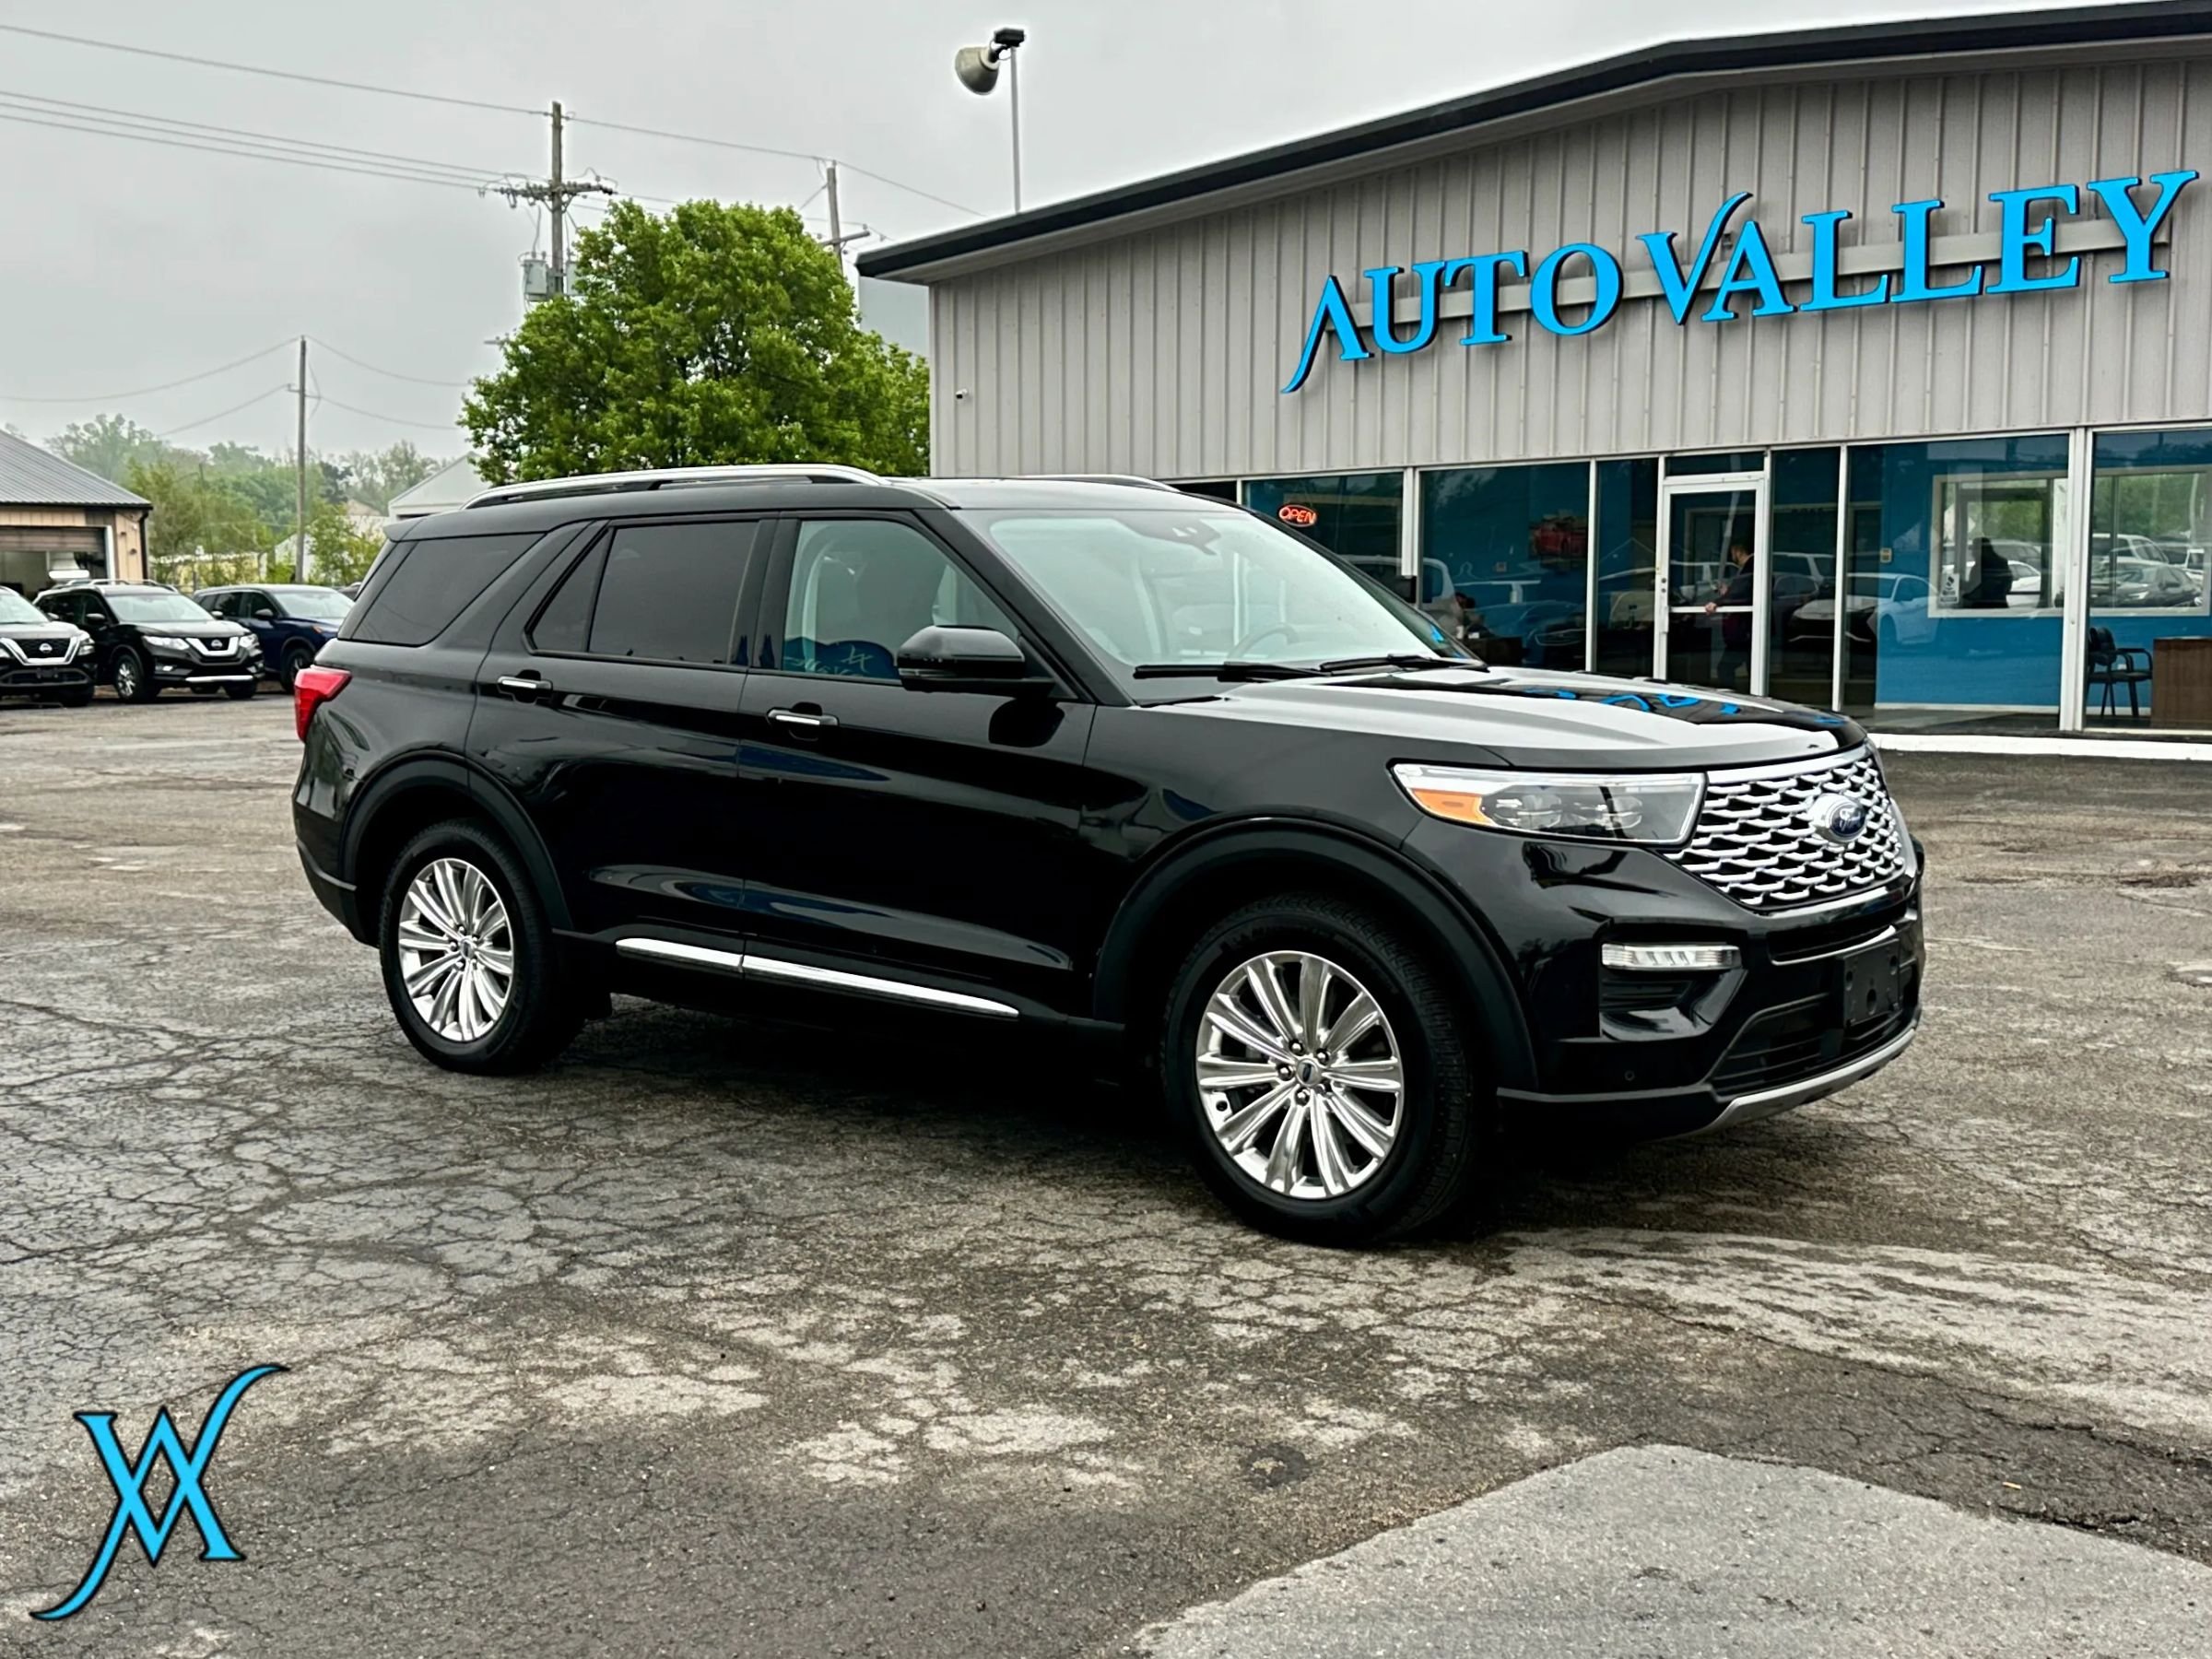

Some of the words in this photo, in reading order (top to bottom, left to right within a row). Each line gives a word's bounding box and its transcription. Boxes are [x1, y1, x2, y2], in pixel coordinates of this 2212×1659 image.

[1280, 242, 1623, 394] AUTO
[1636, 170, 2200, 325] VALLEY
[1278, 506, 1317, 524] OPEN
